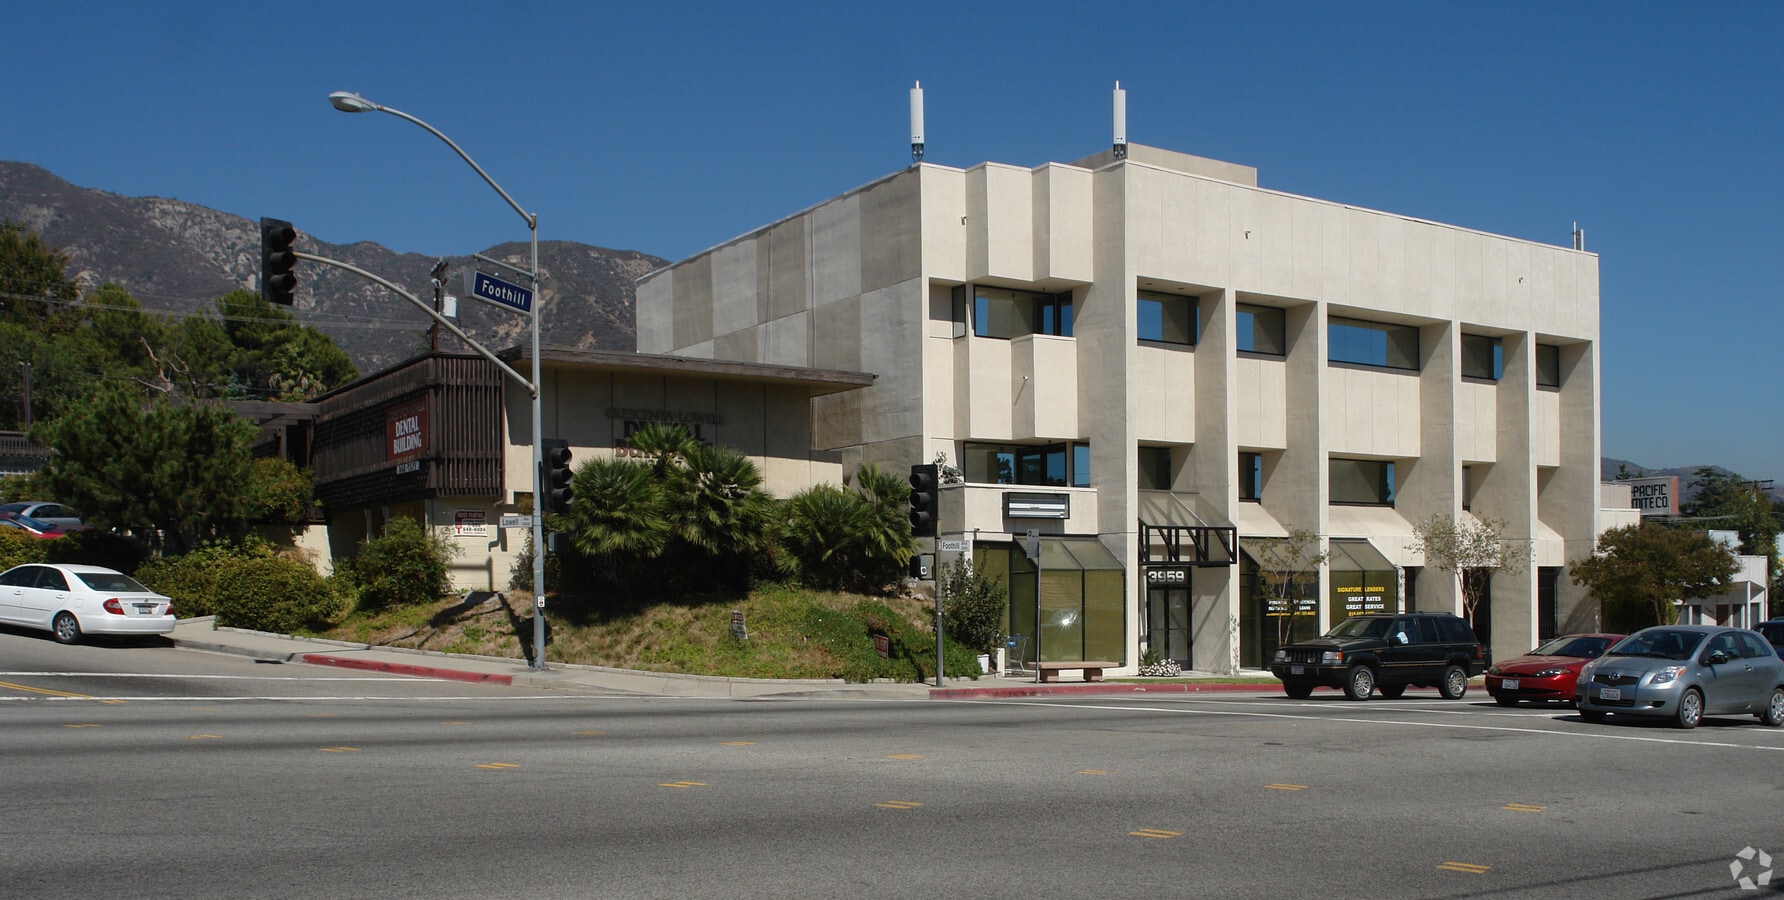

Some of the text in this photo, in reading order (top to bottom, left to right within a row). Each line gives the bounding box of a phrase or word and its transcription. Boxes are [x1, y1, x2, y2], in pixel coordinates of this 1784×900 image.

[481, 279, 526, 306] Foothill
[395, 415, 419, 438] DENTAL
[393, 431, 422, 455] BUILDING
[502, 518, 518, 526] Lowell
[942, 541, 960, 549] Foothill
[1148, 570, 1185, 583] 3959
